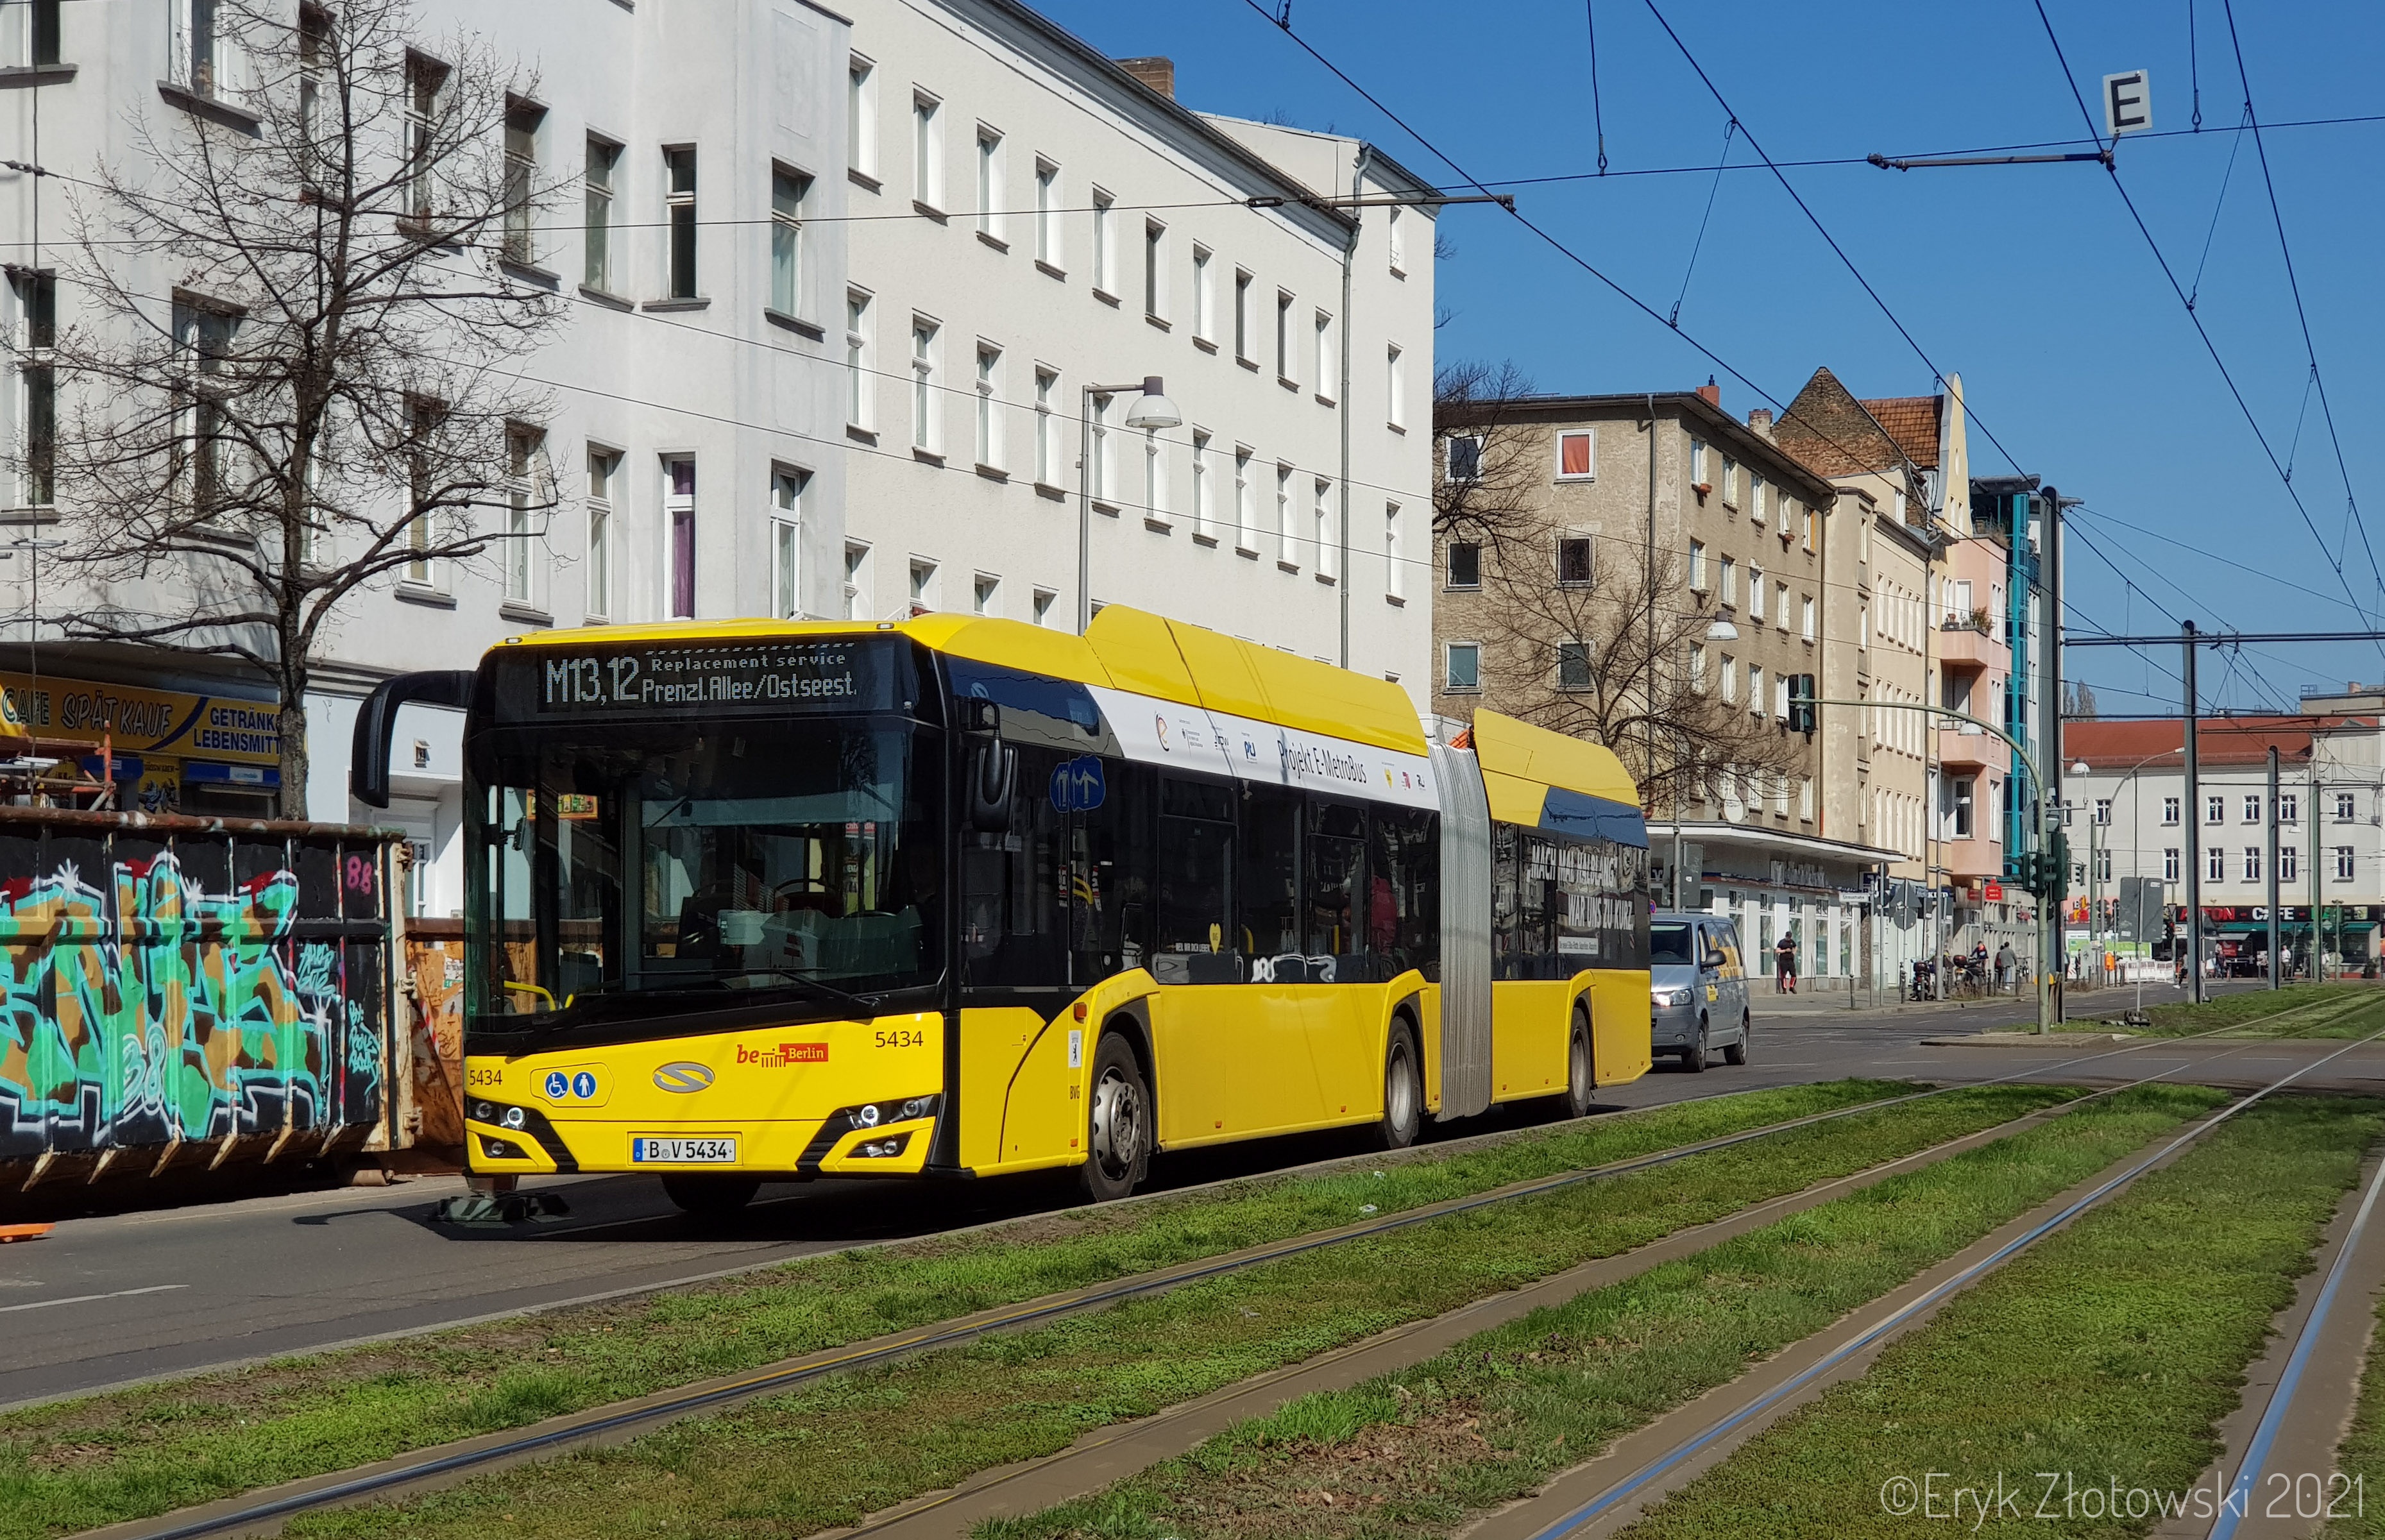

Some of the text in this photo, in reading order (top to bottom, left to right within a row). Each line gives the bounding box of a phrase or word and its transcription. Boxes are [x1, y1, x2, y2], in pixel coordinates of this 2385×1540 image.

[2110, 76, 2145, 128] E
[652, 652, 846, 672] Replacement service
[547, 656, 640, 706] M13,12
[642, 671, 857, 703] Prenzl.Allee/Ostseest.
[61, 690, 173, 737] SPÄT KAUF
[210, 706, 281, 732] GETRÄNK
[1277, 740, 1314, 779] Projekt
[1312, 747, 1368, 784] E-MetroBus
[1568, 894, 1634, 931] WAR UNS ZU KURZ.
[875, 1030, 924, 1047] 5434
[736, 1044, 824, 1063] be Berlin
[470, 1069, 503, 1086] 5434
[1070, 1085, 1080, 1100] BVG
[649, 1141, 727, 1158] B V 5434
